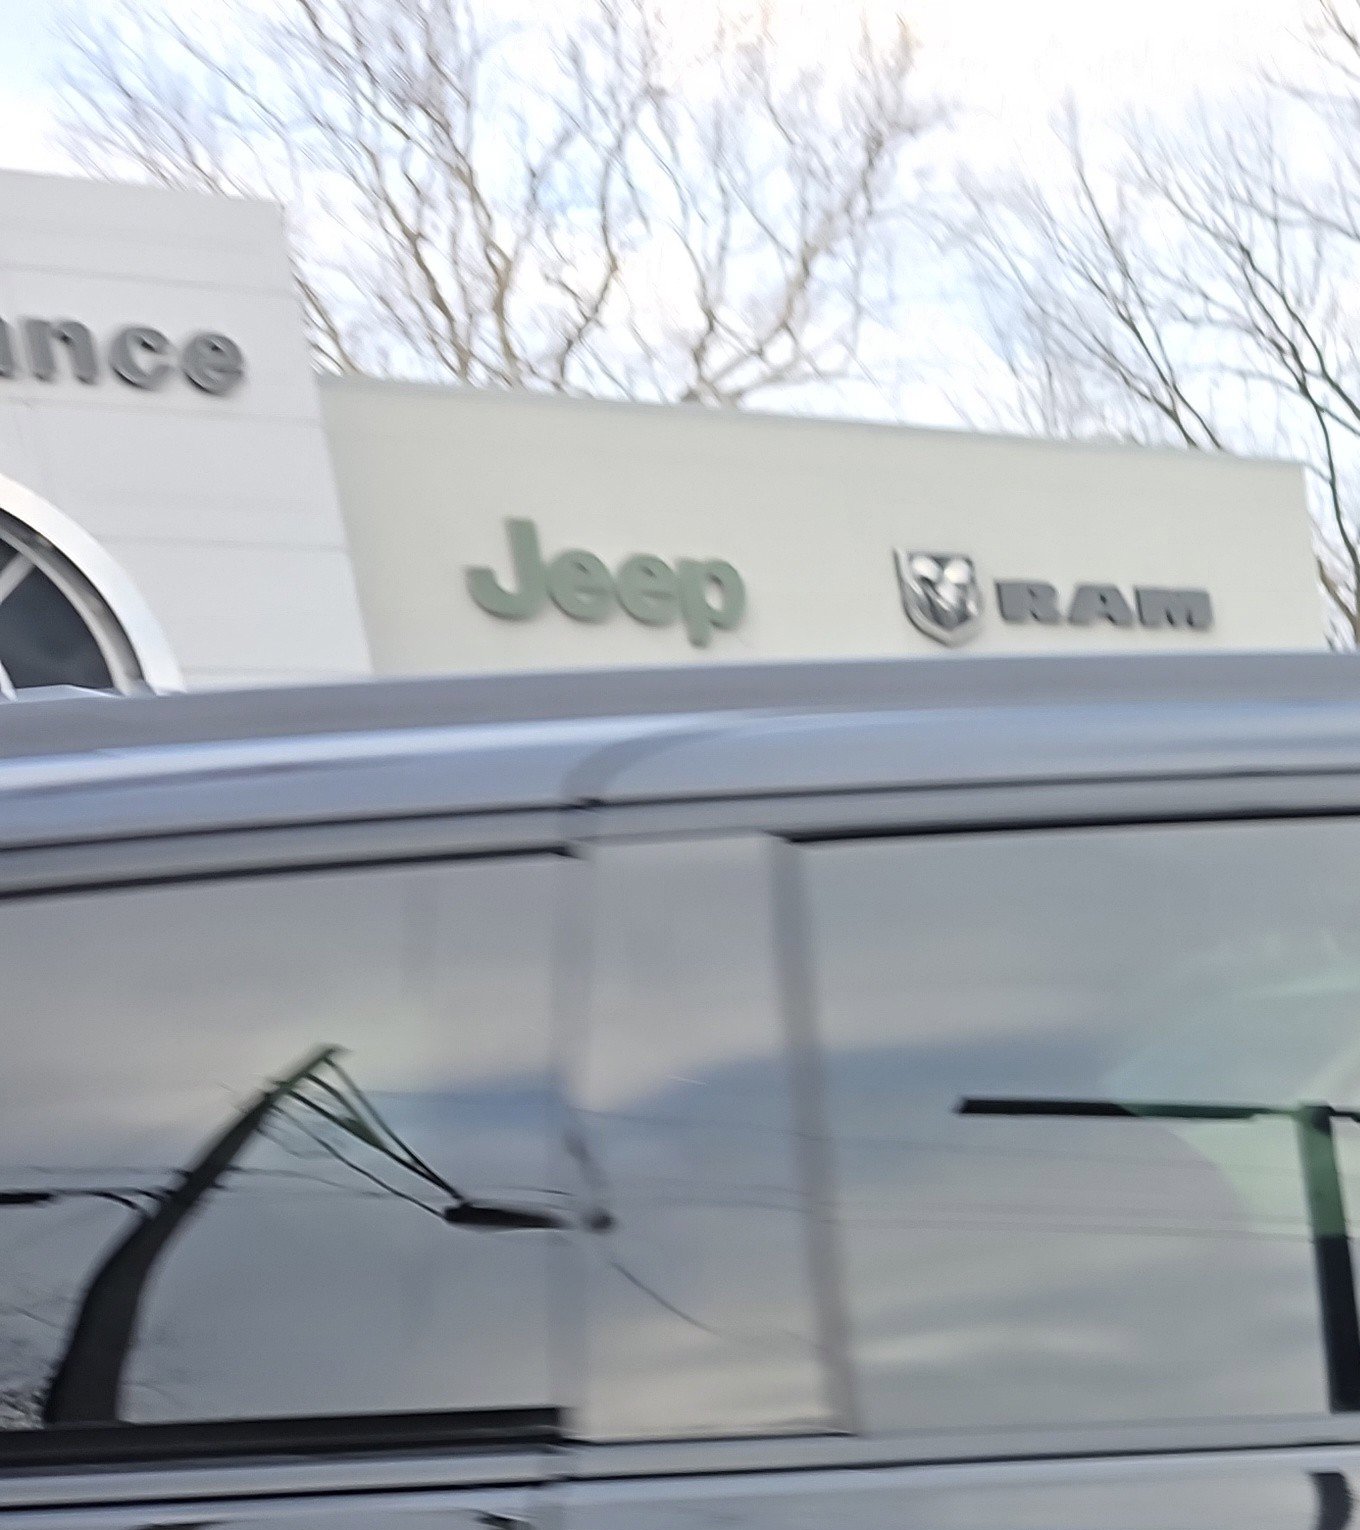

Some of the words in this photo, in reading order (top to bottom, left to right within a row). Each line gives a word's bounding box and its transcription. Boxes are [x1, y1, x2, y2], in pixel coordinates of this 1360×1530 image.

[0, 315, 245, 396] nce
[464, 517, 745, 649] Jeep
[995, 580, 1213, 630] RAM
